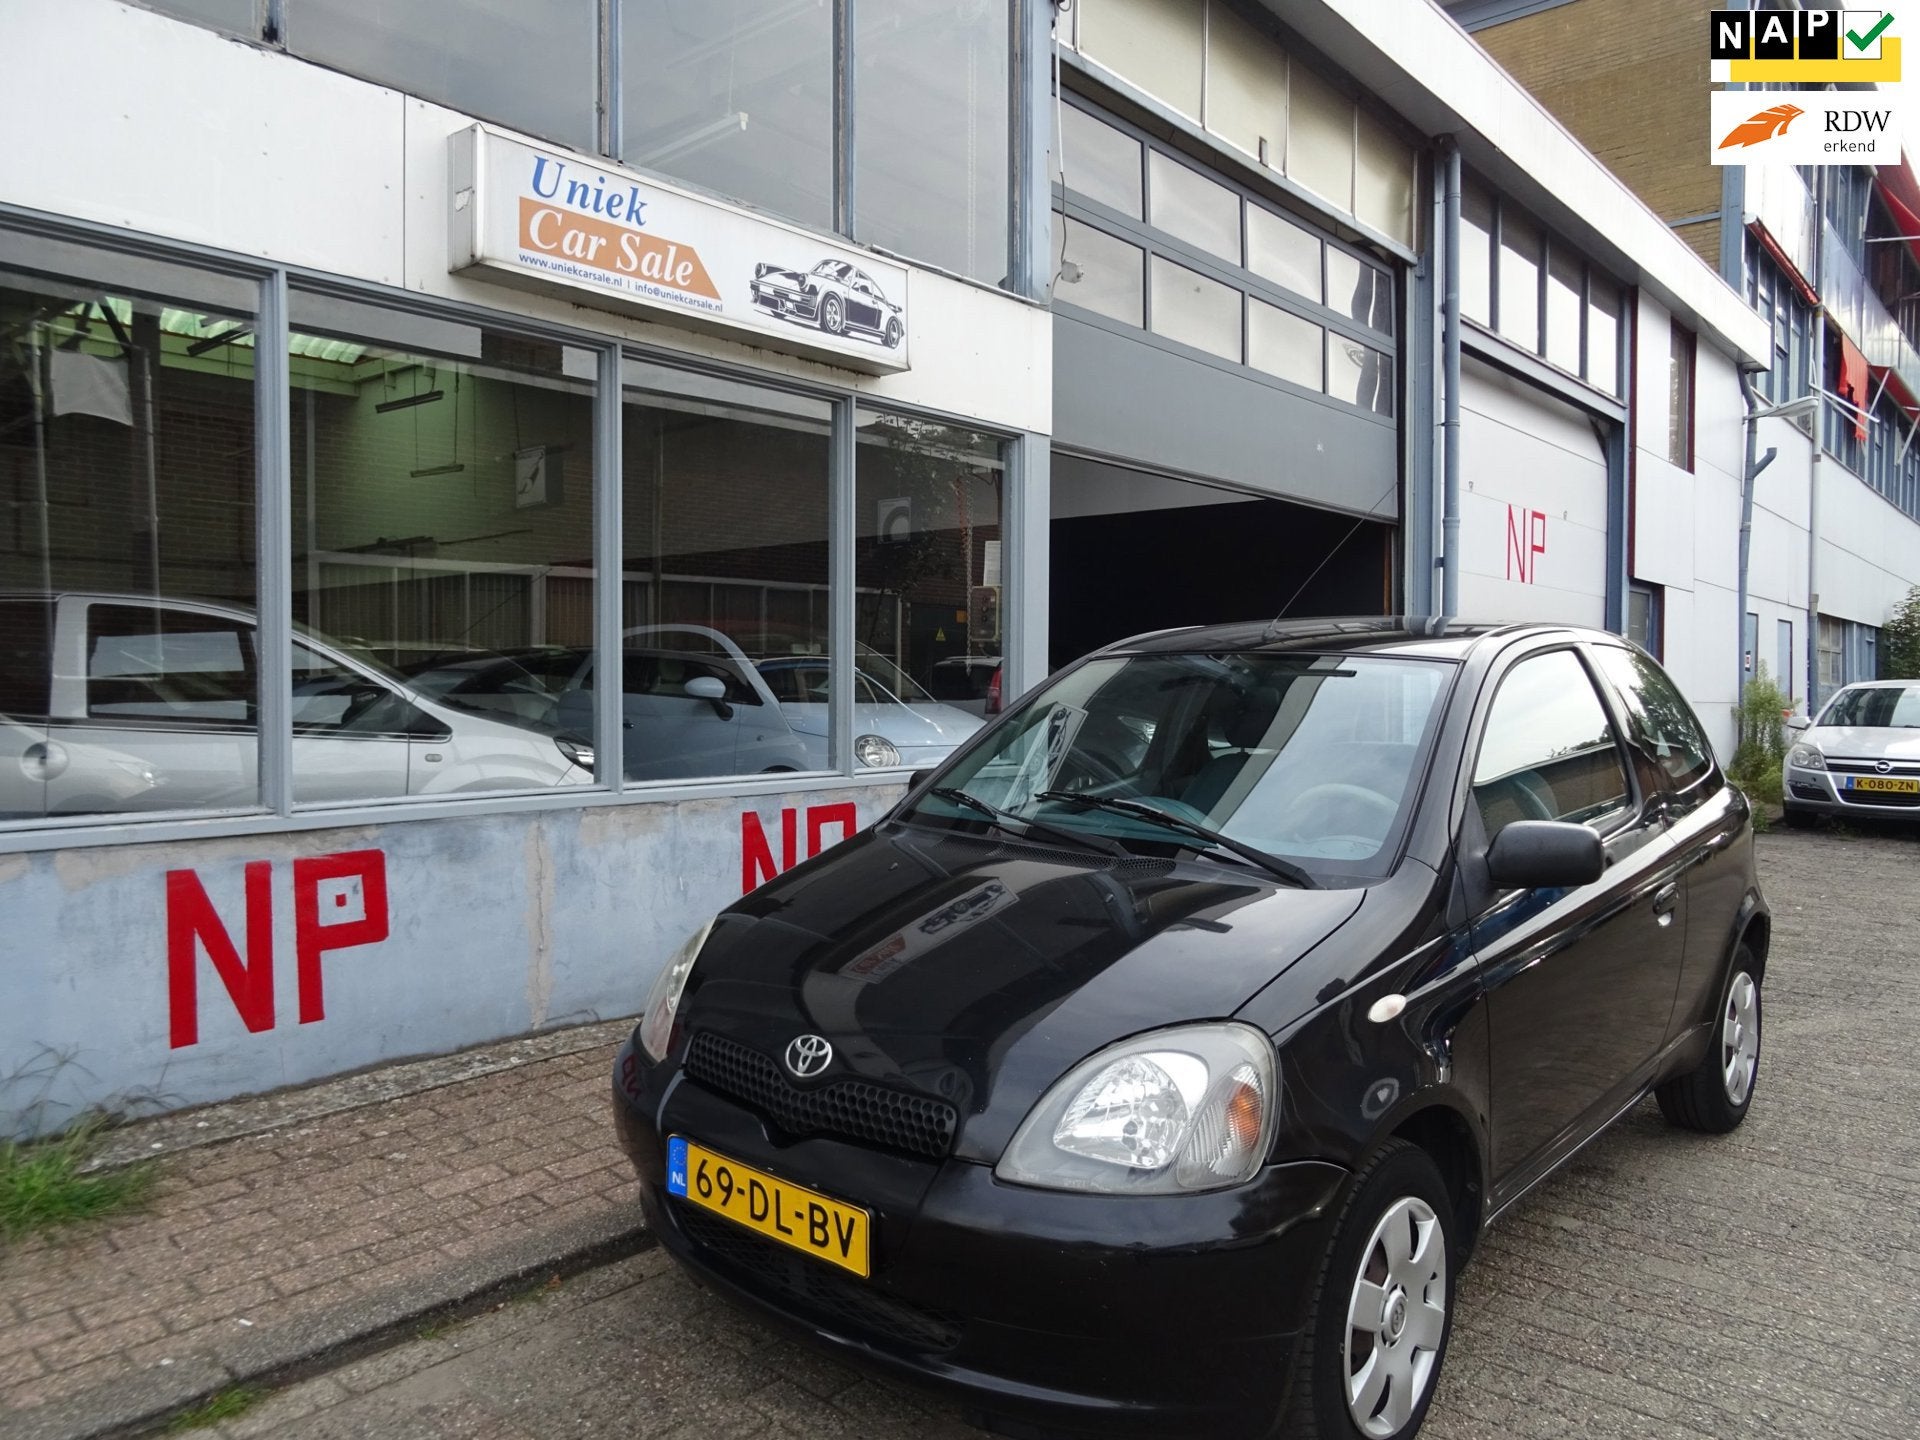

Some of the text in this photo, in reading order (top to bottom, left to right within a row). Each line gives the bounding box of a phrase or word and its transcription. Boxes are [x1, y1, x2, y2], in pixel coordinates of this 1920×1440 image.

[532, 155, 648, 226] Uniek
[519, 253, 723, 313] www.uniekcarsale.nl info@uniekcarsale.nl
[529, 208, 693, 286] Car Sale
[1507, 503, 1546, 585] NP
[1856, 779, 1914, 791] K-080-ZN
[166, 848, 389, 1049] NP
[672, 1159, 855, 1258] NL 69-DL-BV
